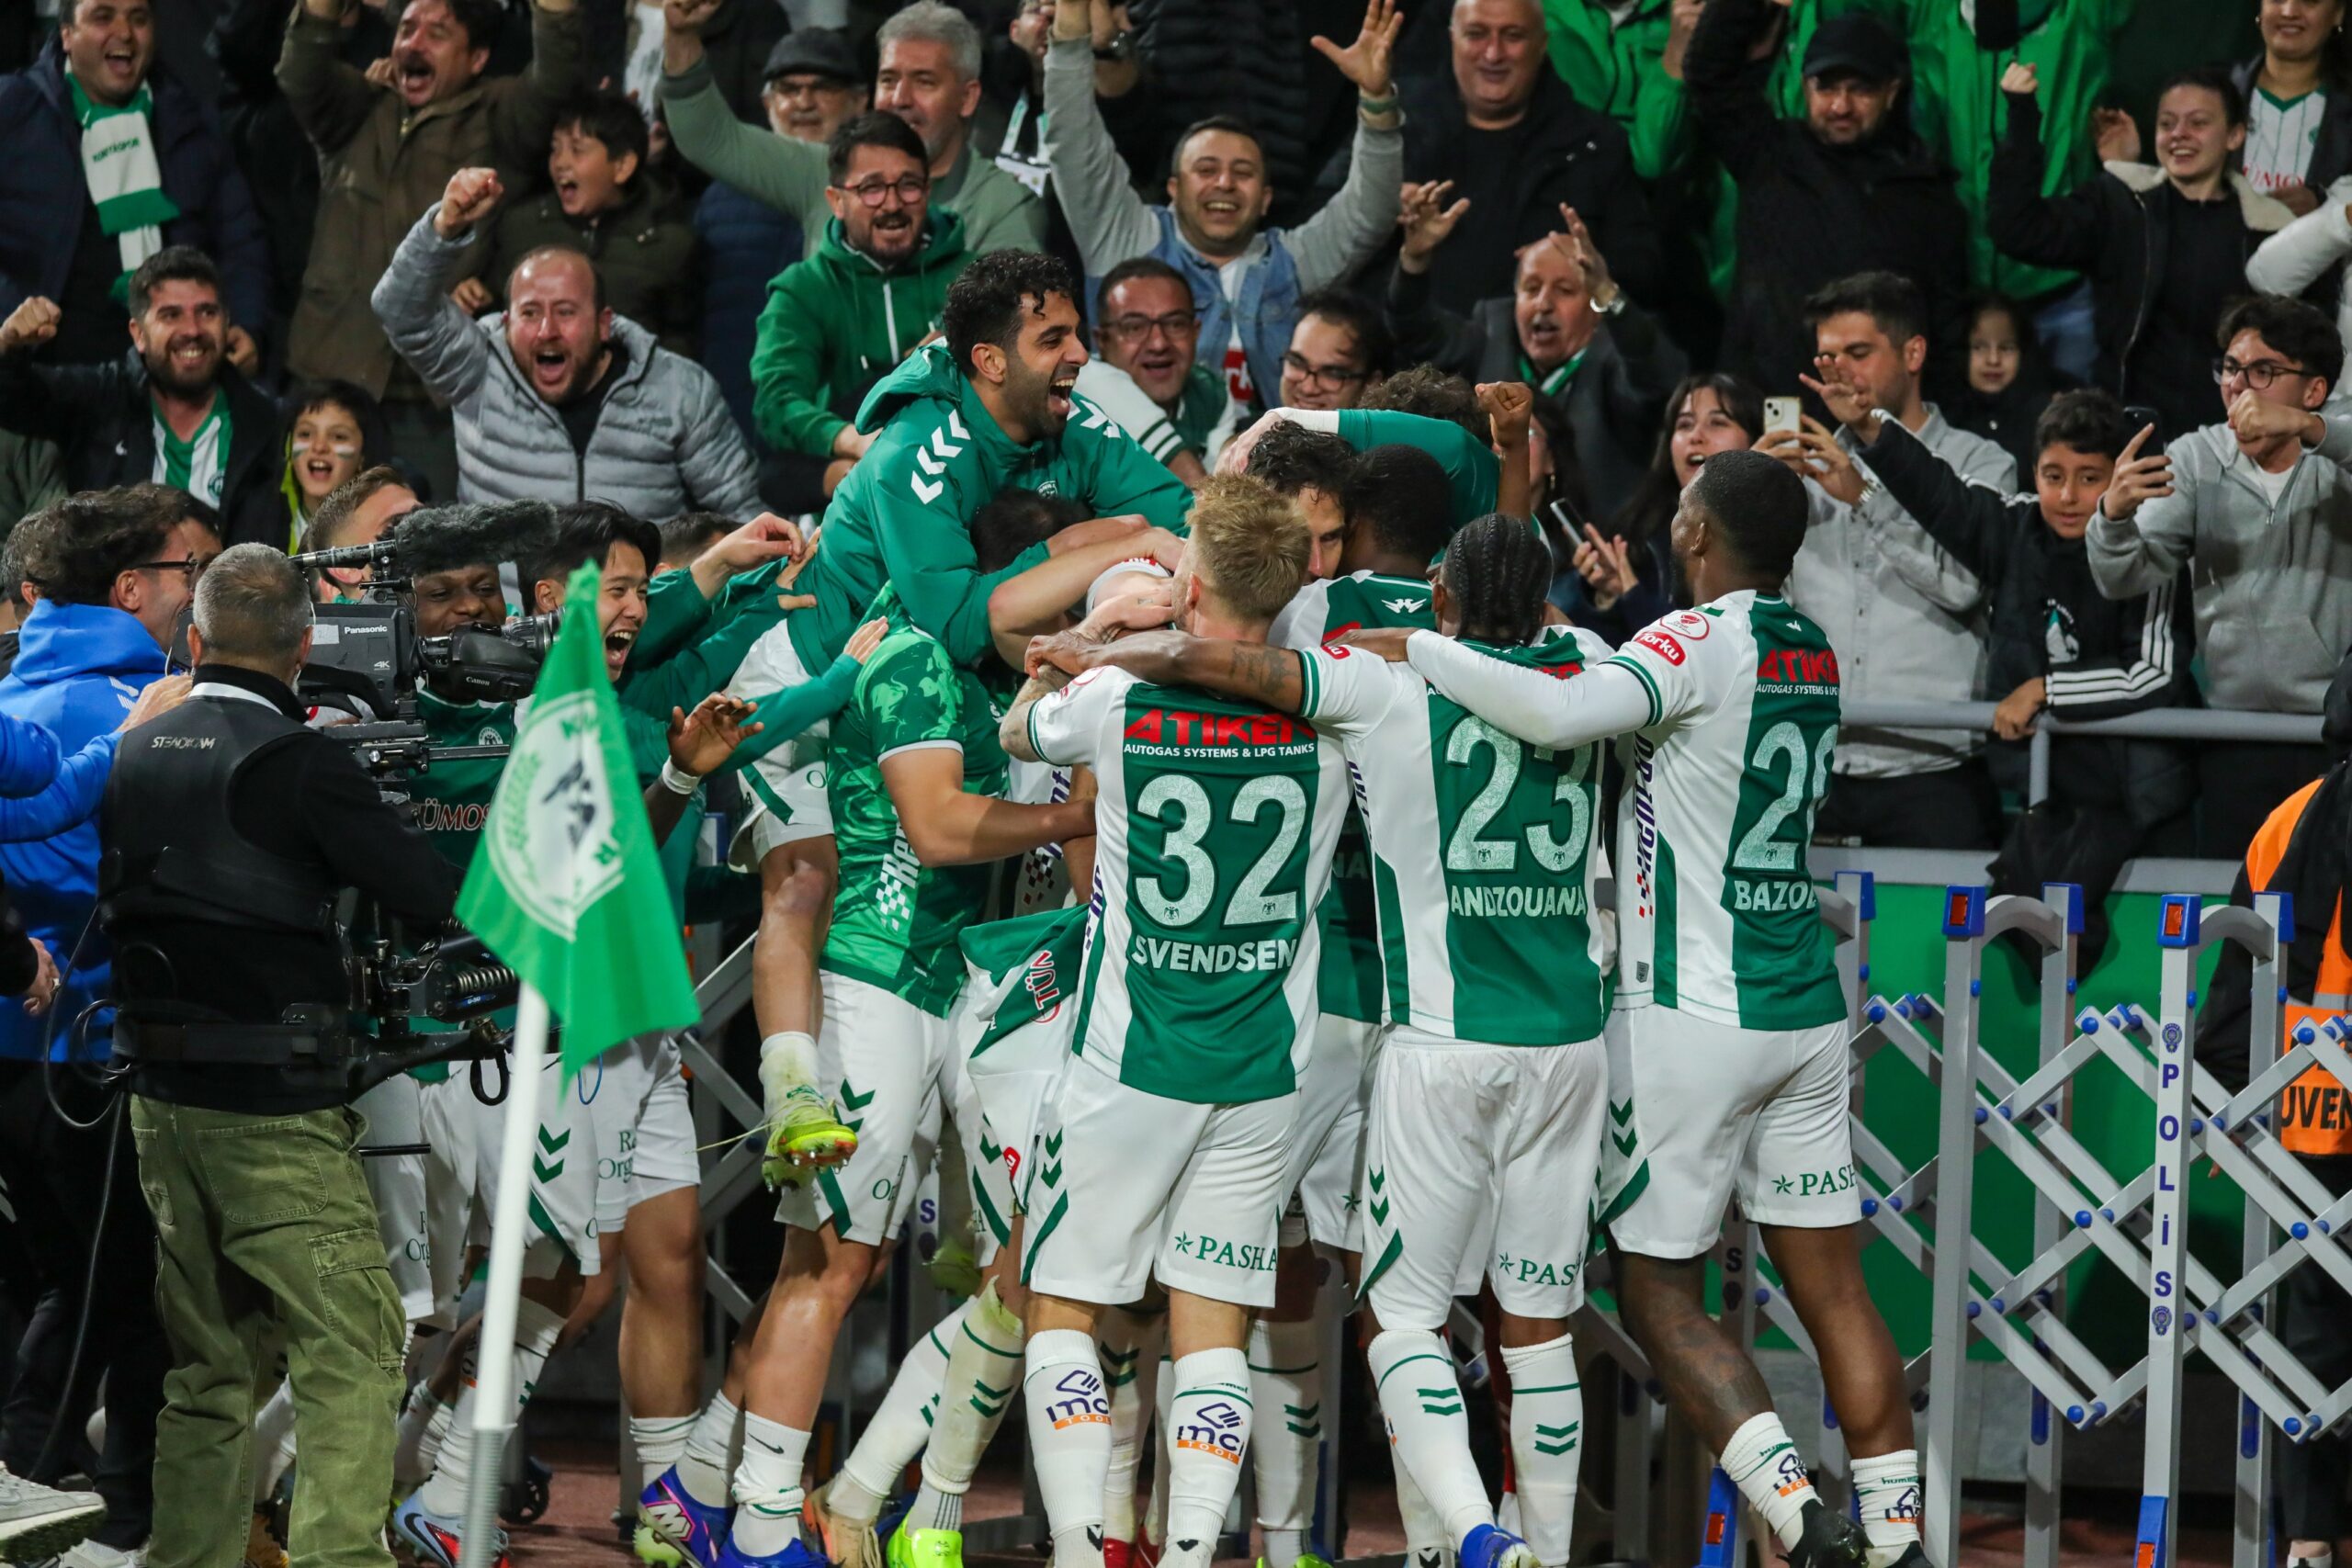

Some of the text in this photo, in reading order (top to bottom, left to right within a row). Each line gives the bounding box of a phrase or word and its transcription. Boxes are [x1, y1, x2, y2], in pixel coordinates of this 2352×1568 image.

[344, 625, 388, 635] Panasonic
[373, 660, 390, 670] 4K
[465, 675, 491, 687] Canon
[1755, 683, 1792, 694] AUTOGAS
[1123, 742, 1316, 758] AUTOGAS SYSTEMS & LPG TANKS
[1446, 714, 1593, 873] 23
[419, 797, 491, 831] ÜMO
[1135, 773, 1307, 927] 32
[1450, 885, 1587, 918] ANDZOUANA
[1131, 934, 1298, 974] SVENDSEN
